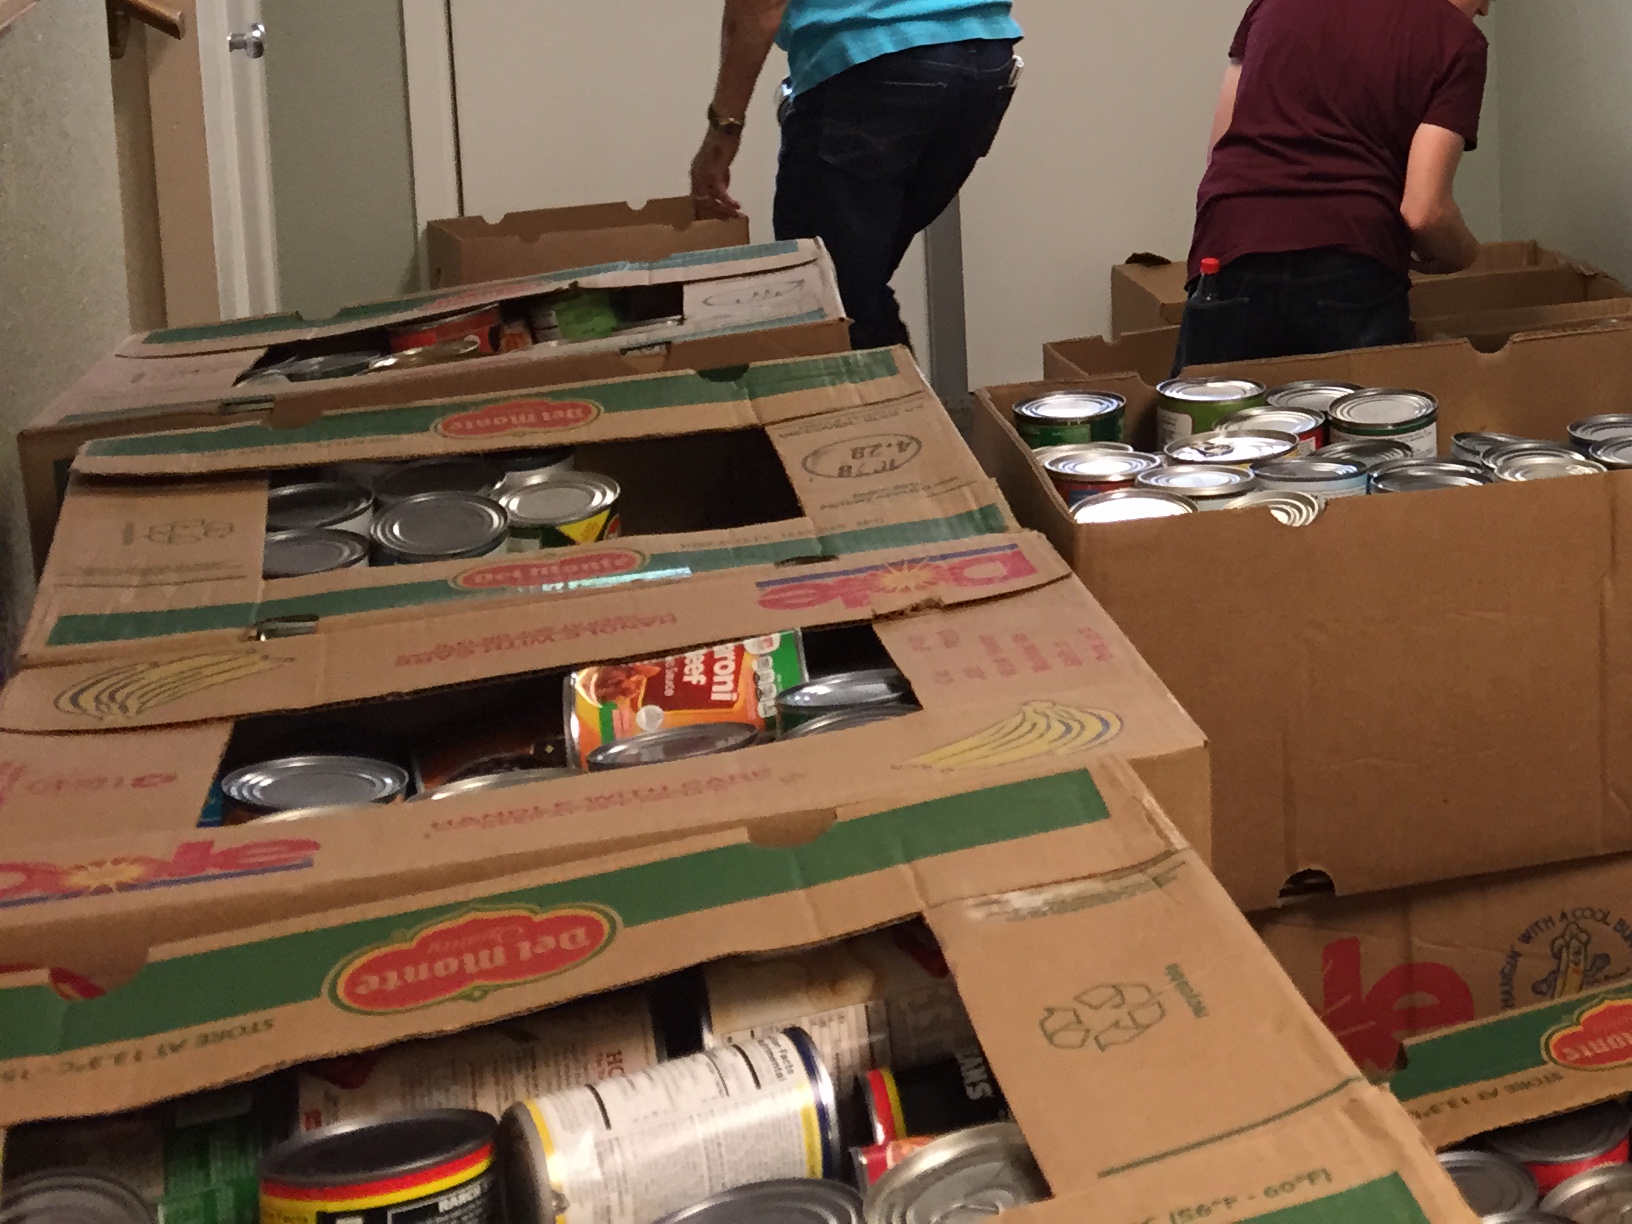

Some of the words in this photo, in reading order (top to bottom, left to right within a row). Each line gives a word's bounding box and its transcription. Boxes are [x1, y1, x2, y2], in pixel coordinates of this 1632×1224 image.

[542, 408, 585, 422] Del
[514, 923, 593, 962] Del
[353, 950, 506, 1000] Monte
[155, 1038, 187, 1060] AT
[189, 1016, 277, 1050] STORE
